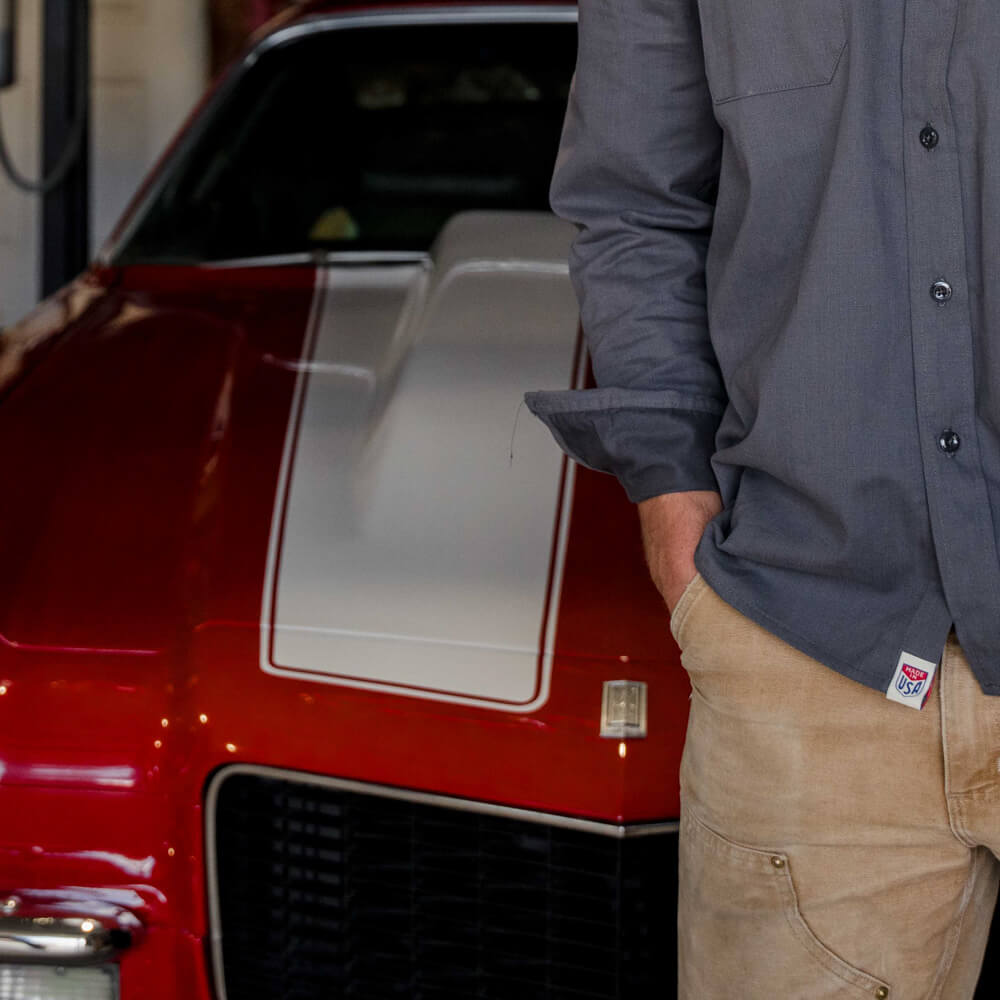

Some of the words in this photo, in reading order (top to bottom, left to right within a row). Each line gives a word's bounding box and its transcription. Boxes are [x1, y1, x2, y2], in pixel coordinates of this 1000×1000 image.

[905, 666, 925, 678] MADE
[909, 672, 918, 680] IN
[898, 675, 923, 695] USA
